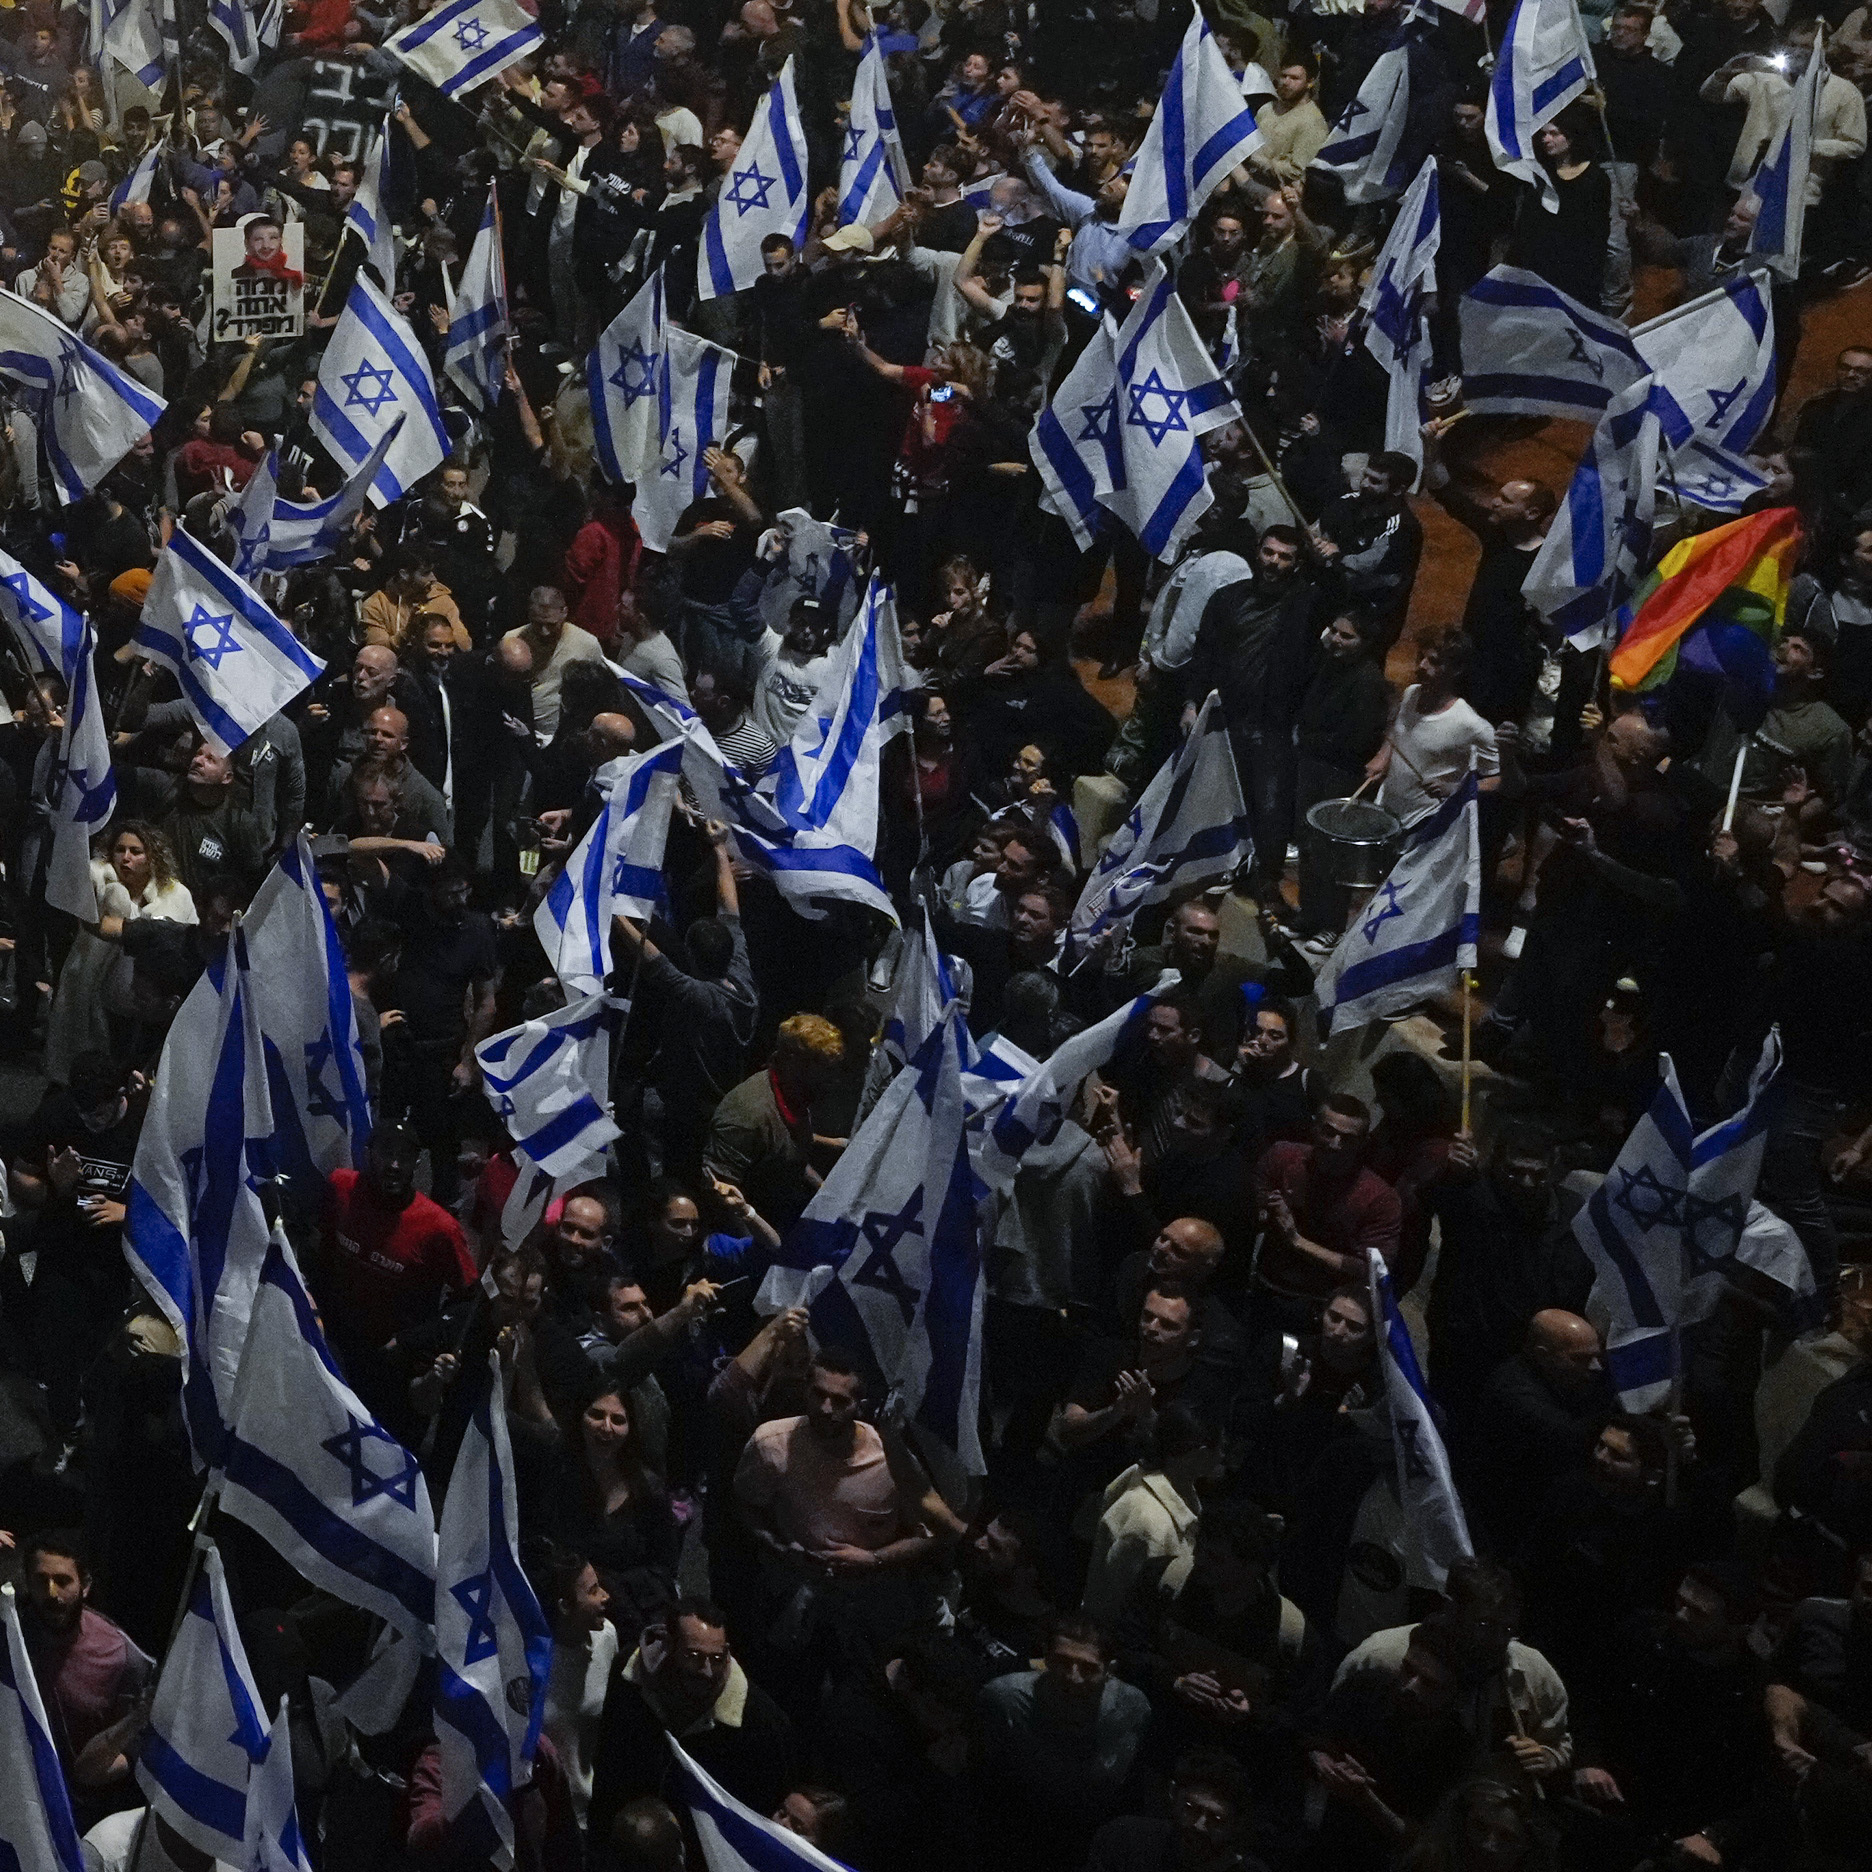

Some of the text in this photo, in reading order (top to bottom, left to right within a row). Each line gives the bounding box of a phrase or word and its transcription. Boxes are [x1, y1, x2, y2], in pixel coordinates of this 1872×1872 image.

[235, 277, 287, 296] ממה
[236, 295, 287, 316] אתה
[216, 308, 295, 337] מפחד?
